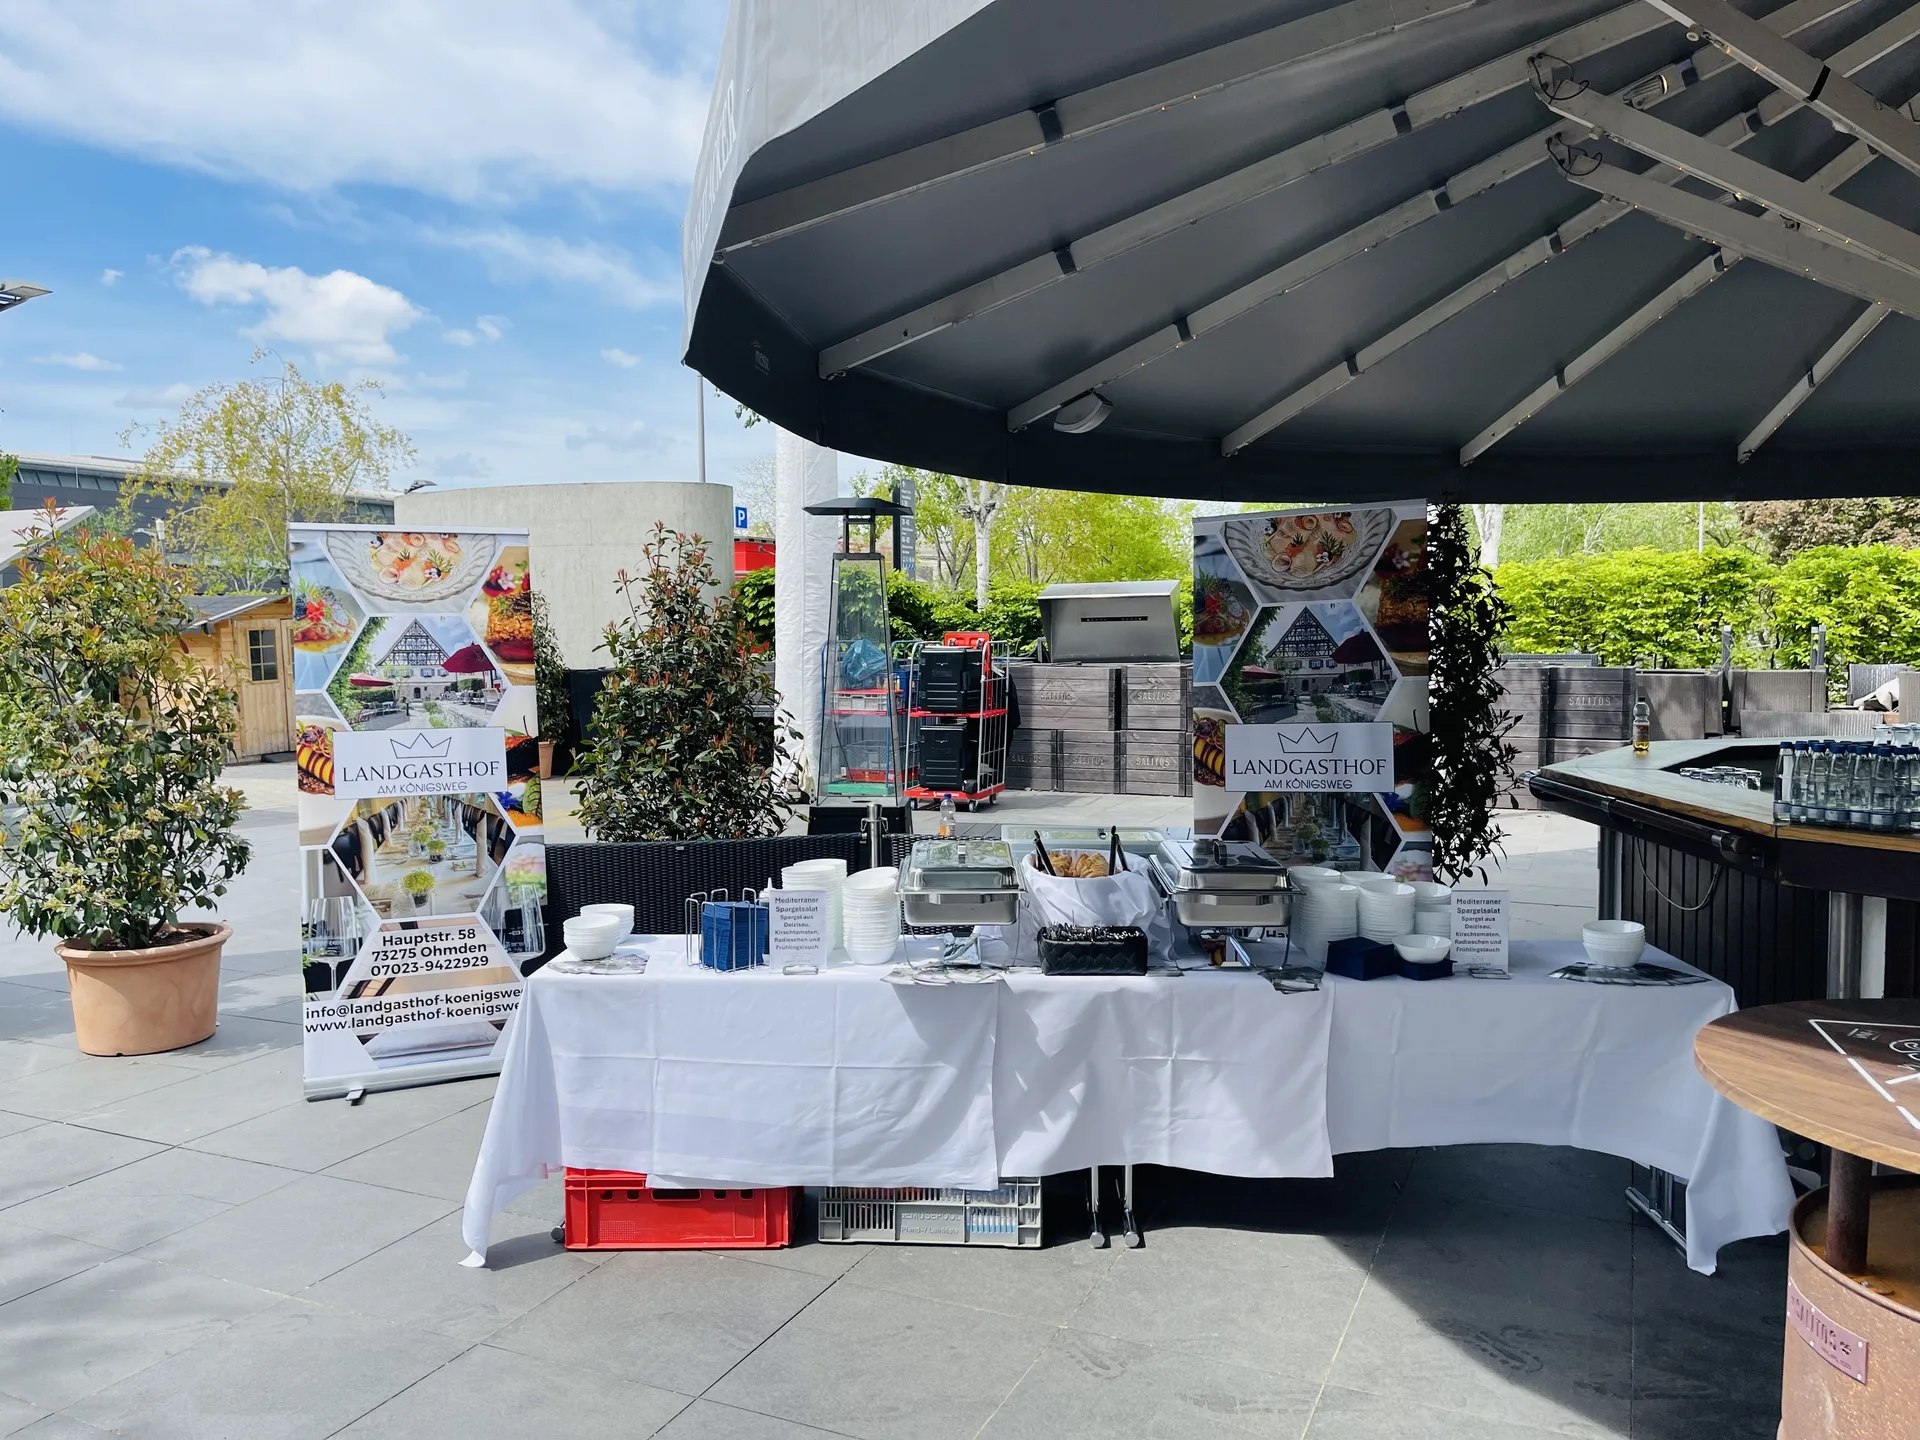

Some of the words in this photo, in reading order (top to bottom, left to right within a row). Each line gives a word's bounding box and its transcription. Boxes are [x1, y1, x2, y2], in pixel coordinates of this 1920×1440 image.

[738, 509, 746, 526] P
[1137, 691, 1172, 700] SALITOS
[1568, 696, 1611, 706] SALITOS
[1072, 755, 1105, 765] SALITOS
[1136, 756, 1170, 767] SALITOS
[1232, 758, 1387, 776] LANDGASTHOF
[342, 760, 500, 782] LANDGASTHOF
[377, 784, 397, 795] AM
[1264, 779, 1283, 789] AM
[382, 931, 455, 947] Hauptstr.
[458, 928, 476, 940] 58
[371, 947, 417, 962] 73275
[420, 942, 487, 957] Ohmden
[370, 955, 489, 977] 07023-9422929
[305, 987, 523, 1019] info@landgasthof-koenigswe
